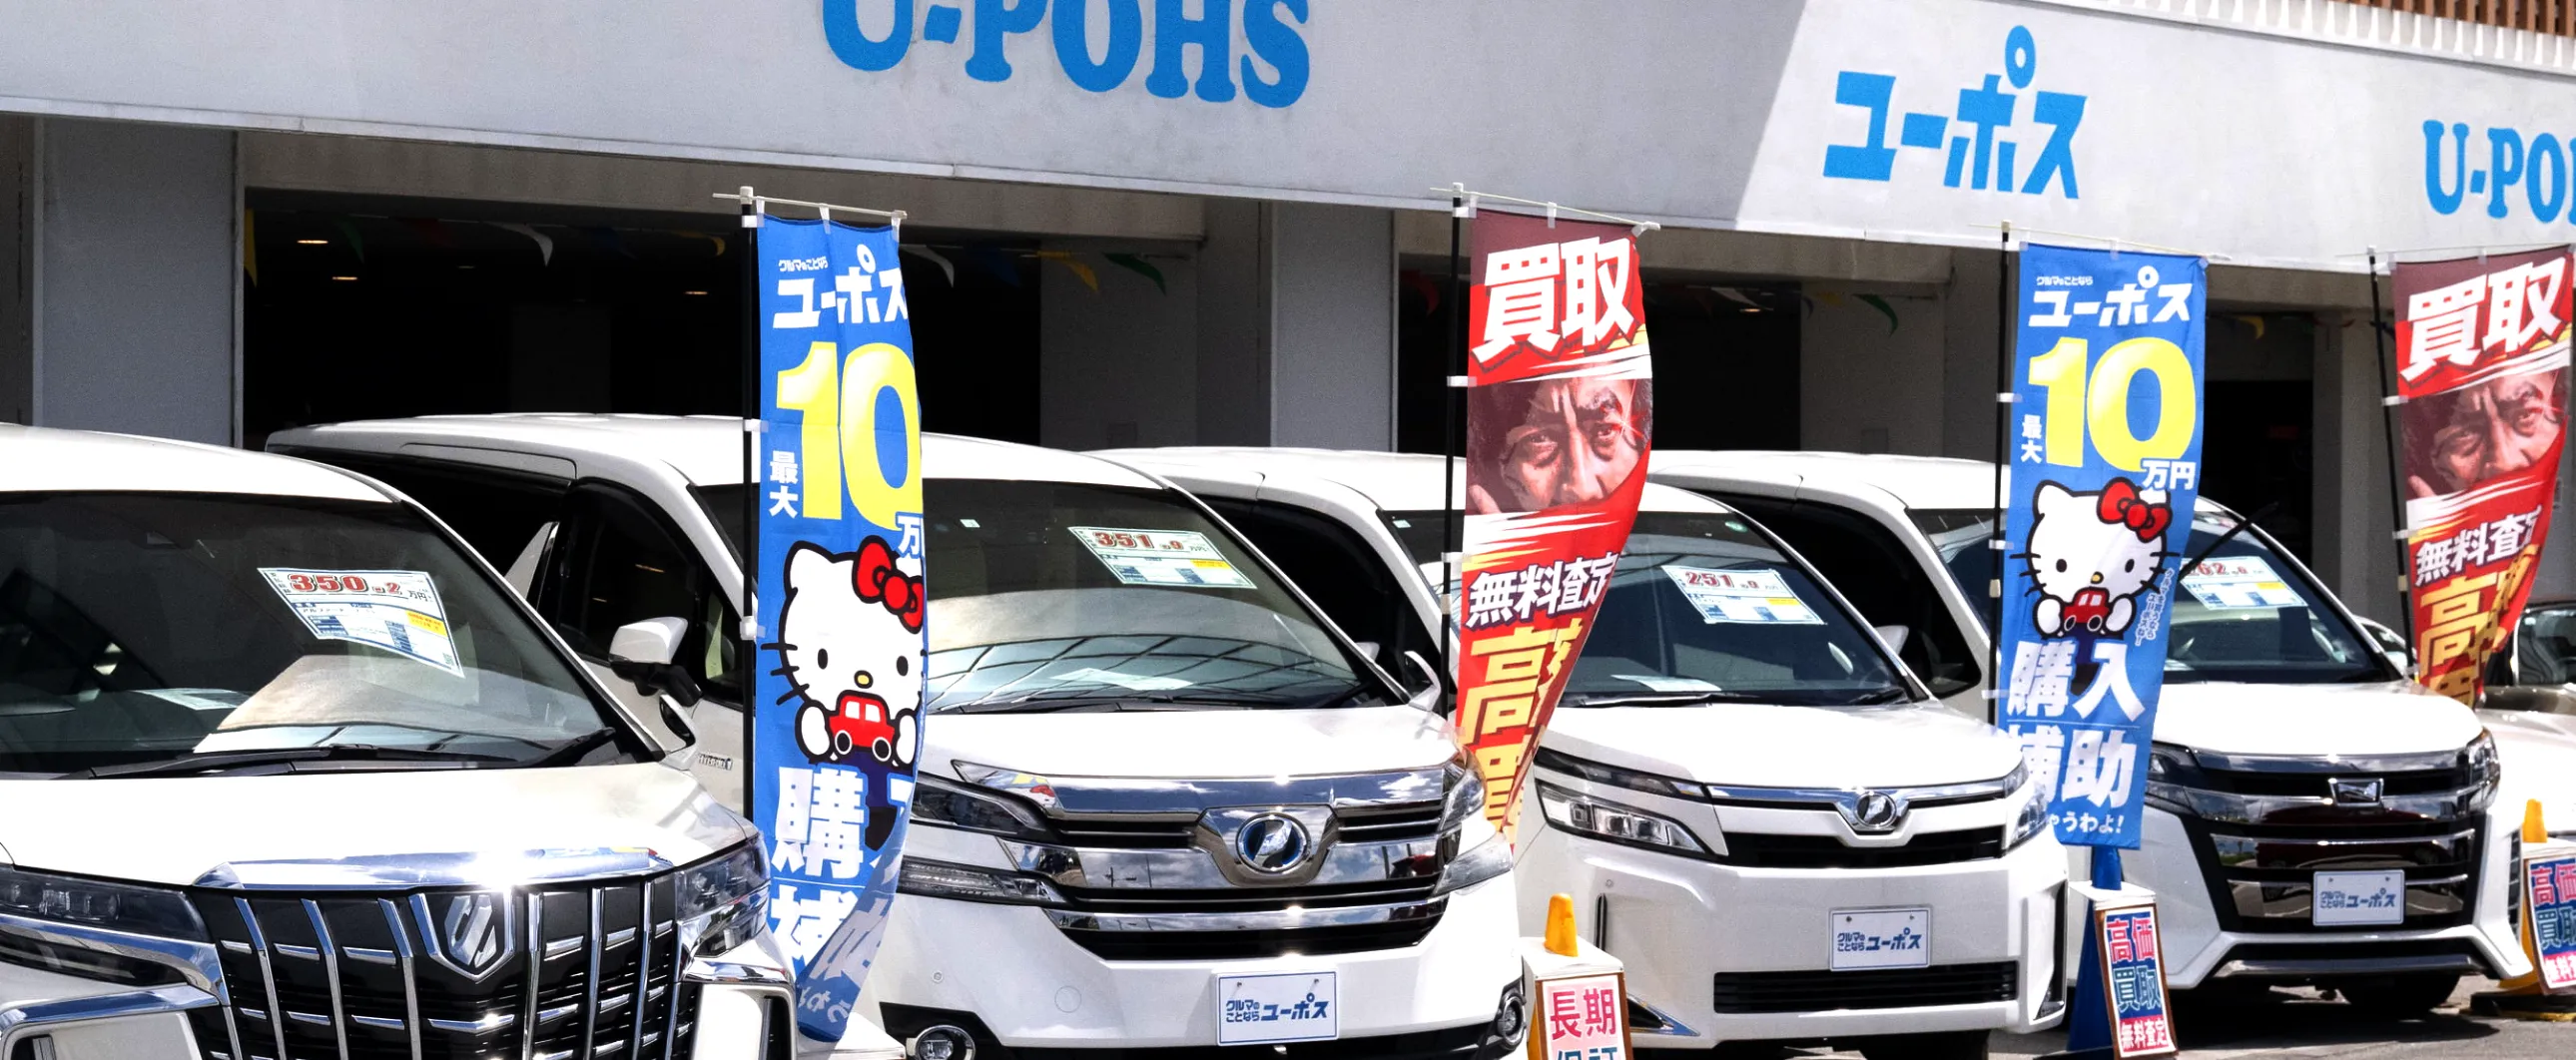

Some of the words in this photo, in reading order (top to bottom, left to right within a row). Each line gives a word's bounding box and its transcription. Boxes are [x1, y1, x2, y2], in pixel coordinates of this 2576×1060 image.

[823, 0, 1310, 108] U-POHS
[1823, 25, 2088, 200] ユーポス
[2422, 120, 2576, 224] U-PO
[773, 244, 909, 328] ユーポス
[1472, 237, 1634, 363] 買取
[2028, 265, 2194, 327] ユーポス
[2399, 256, 2567, 382] 買取
[2028, 336, 2197, 473] 10
[776, 341, 924, 531] 10
[2020, 413, 2044, 465] 最大
[769, 450, 799, 519] 最大
[2141, 459, 2198, 491] 万円
[897, 514, 925, 558] 万
[2006, 640, 2146, 723] 購入
[2346, 887, 2396, 907] ユーポス
[2530, 863, 2576, 906] 高価
[1837, 932, 1866, 942] クルマの
[1837, 942, 1865, 952] ことなら
[1865, 927, 1922, 951] ユーポス
[2106, 917, 2156, 965] 高価
[1226, 999, 1260, 1012] クルマの
[1260, 992, 1329, 1022] ユーポス
[1550, 987, 1617, 1041] 長期
[2113, 965, 2162, 1013] 買取
[1226, 1011, 1260, 1023] ことなら
[2120, 1018, 2169, 1050] 無料査定
